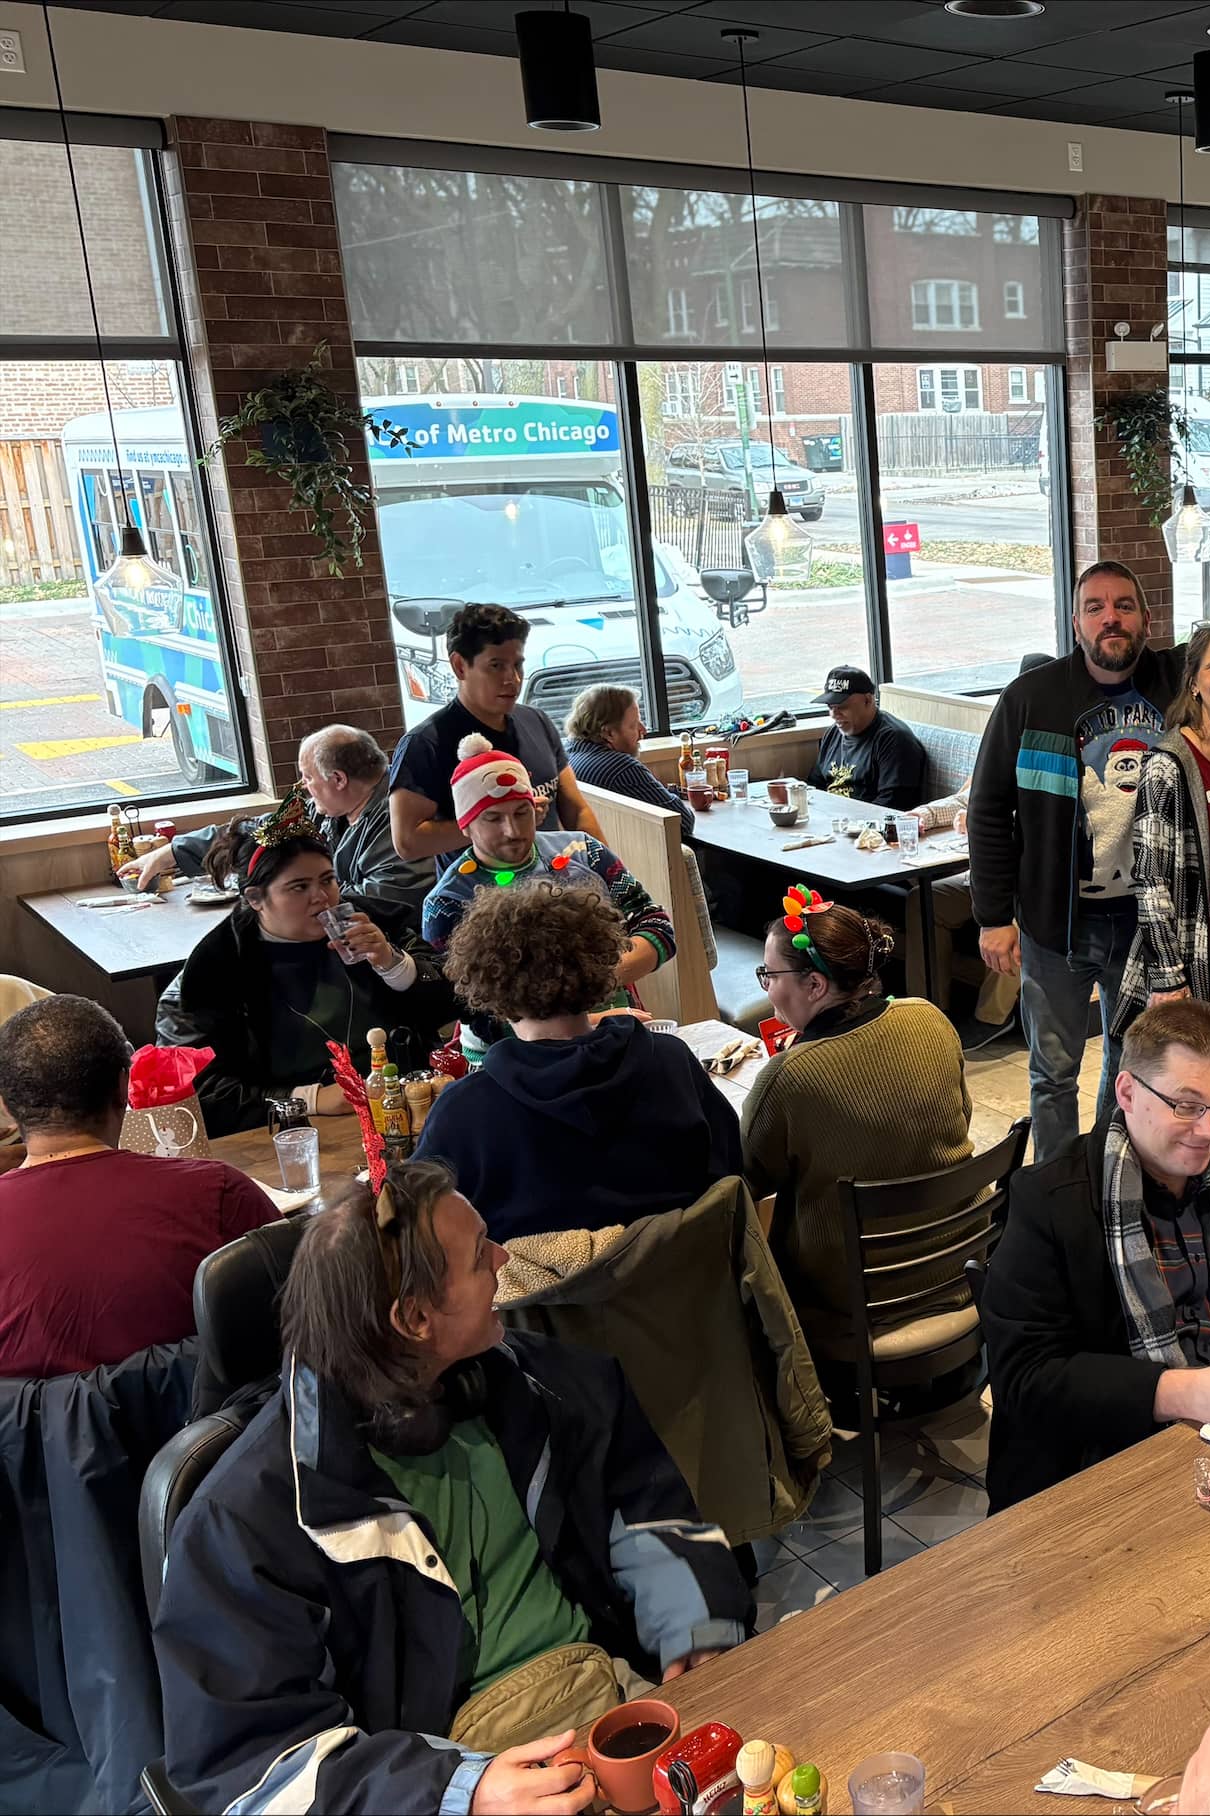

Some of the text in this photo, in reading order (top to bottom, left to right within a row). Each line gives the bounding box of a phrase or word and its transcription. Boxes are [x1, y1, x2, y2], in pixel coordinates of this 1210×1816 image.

[415, 423, 440, 444] of
[448, 423, 517, 444] Metro
[523, 421, 610, 445] Chicago
